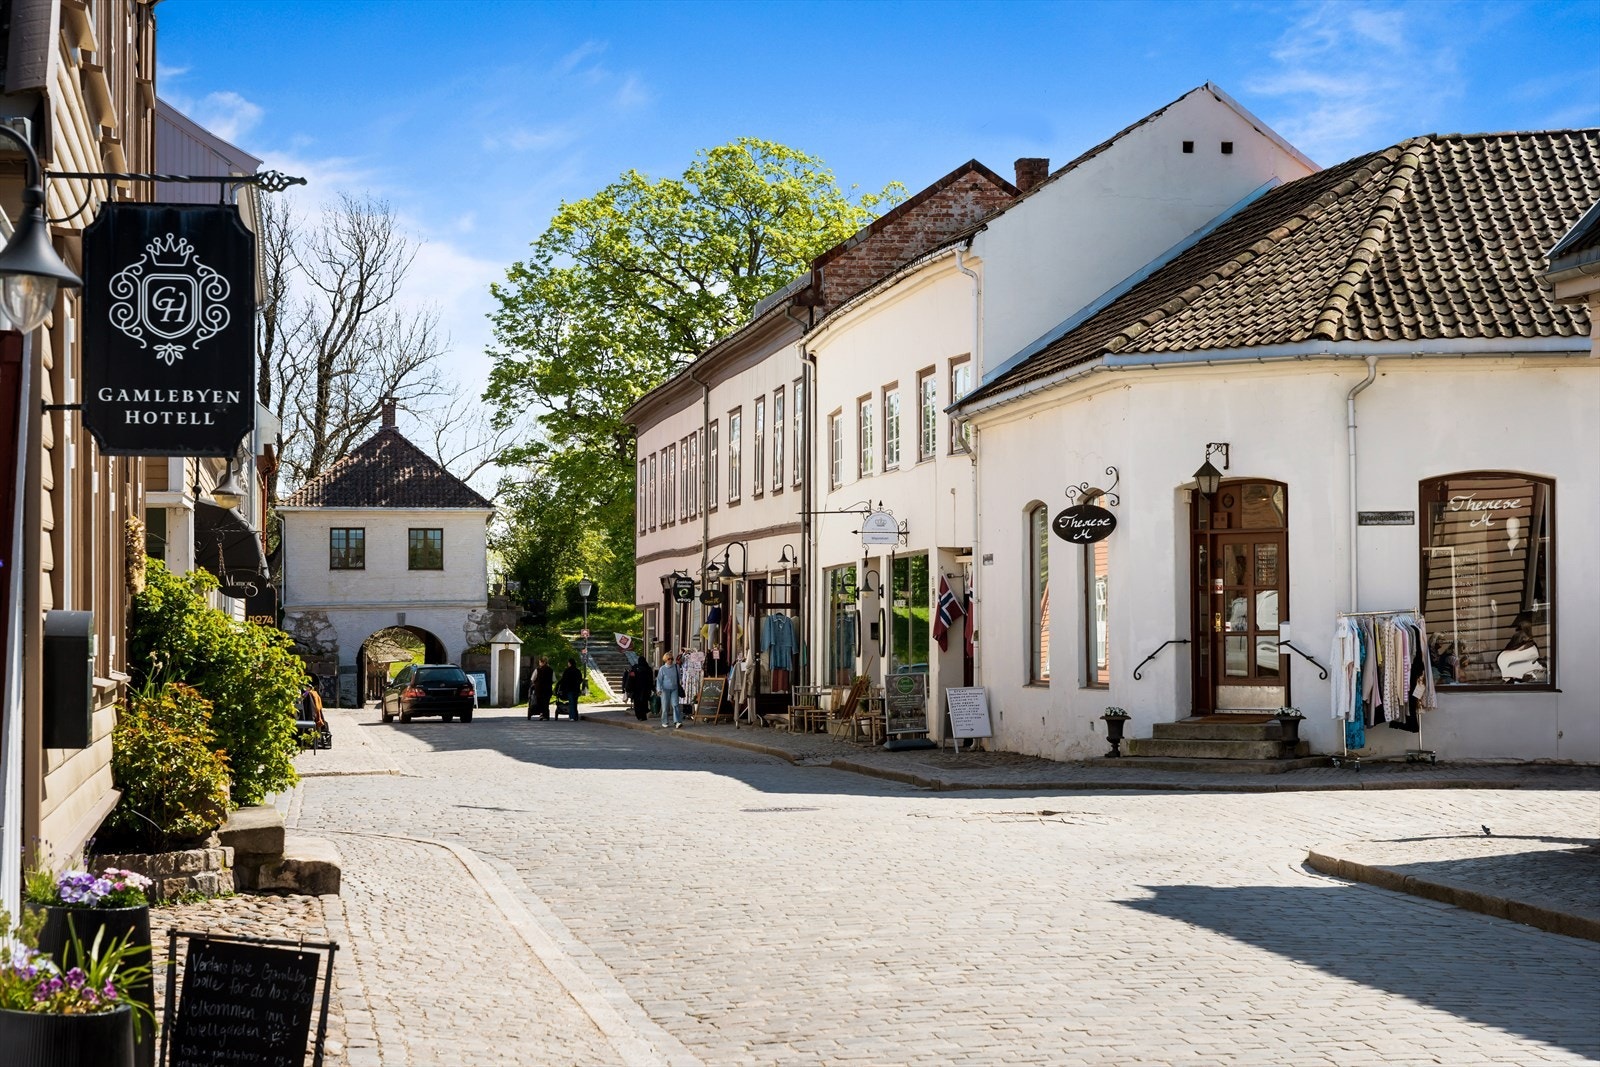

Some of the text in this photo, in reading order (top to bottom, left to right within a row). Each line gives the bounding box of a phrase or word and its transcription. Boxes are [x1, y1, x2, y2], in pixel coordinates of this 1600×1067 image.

[151, 286, 187, 322] GH
[98, 387, 240, 403] GAMLEBYEN
[125, 410, 215, 425] HOTELL
[1450, 492, 1521, 511] Therese
[1059, 513, 1111, 528] Therese
[1470, 511, 1495, 527] M
[1073, 529, 1092, 540] M
[182, 996, 257, 1020] Velkommen
